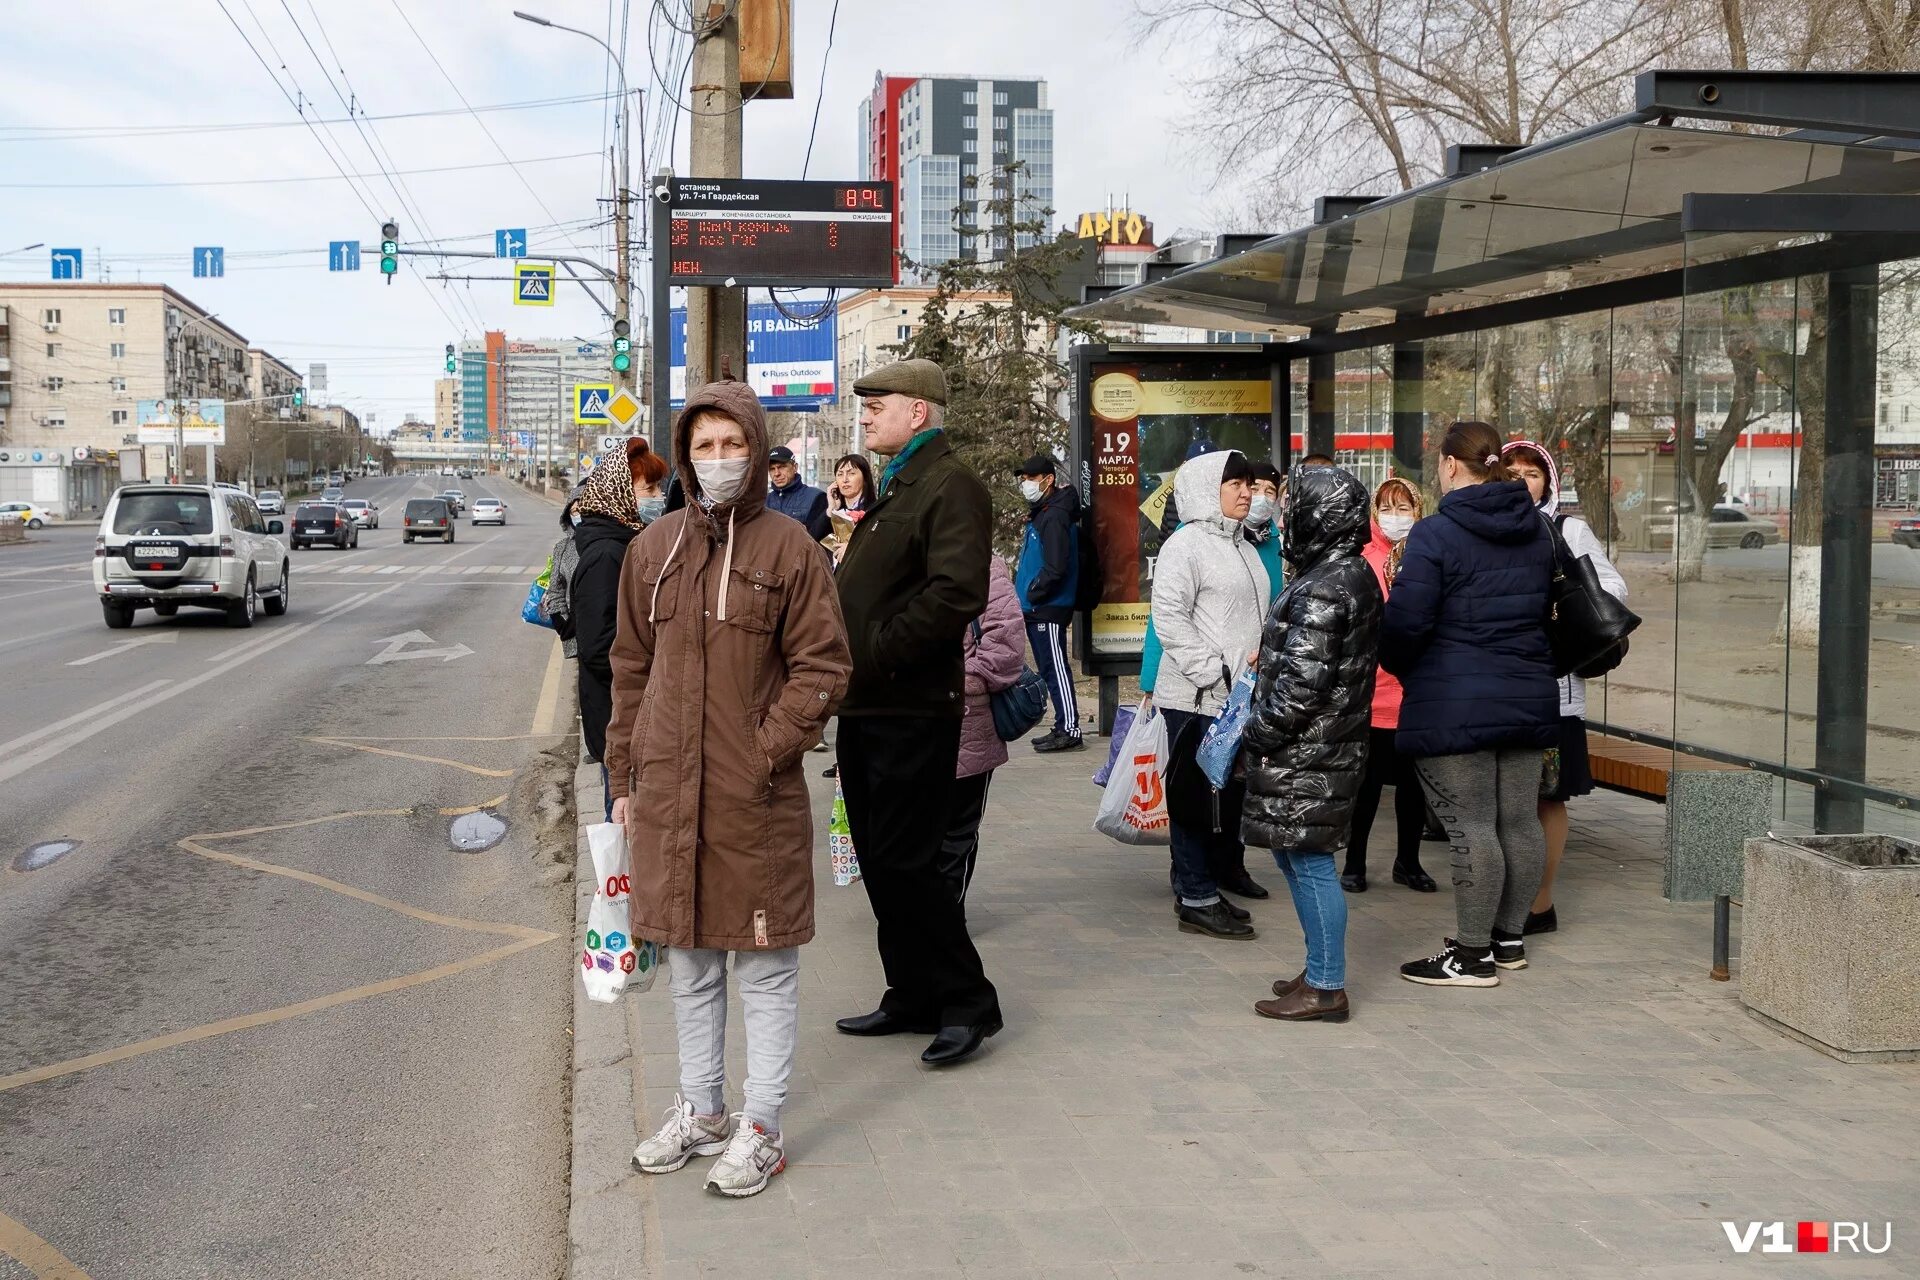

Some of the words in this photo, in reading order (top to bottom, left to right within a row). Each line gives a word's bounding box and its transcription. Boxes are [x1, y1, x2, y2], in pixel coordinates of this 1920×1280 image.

[679, 192, 692, 201] ул.
[693, 192, 706, 200] 7-я
[708, 192, 760, 202] Гвардейская
[1079, 211, 1144, 245] АРГО
[790, 369, 822, 377] Outdoor
[1102, 432, 1131, 453] 19
[1098, 455, 1135, 465] МАРТА
[1103, 465, 1129, 473] Четверг
[1098, 473, 1135, 485] 18:30
[1106, 613, 1129, 621] Заказ
[1123, 811, 1169, 830] МАГНИТ
[1430, 799, 1475, 889] SPORTS
